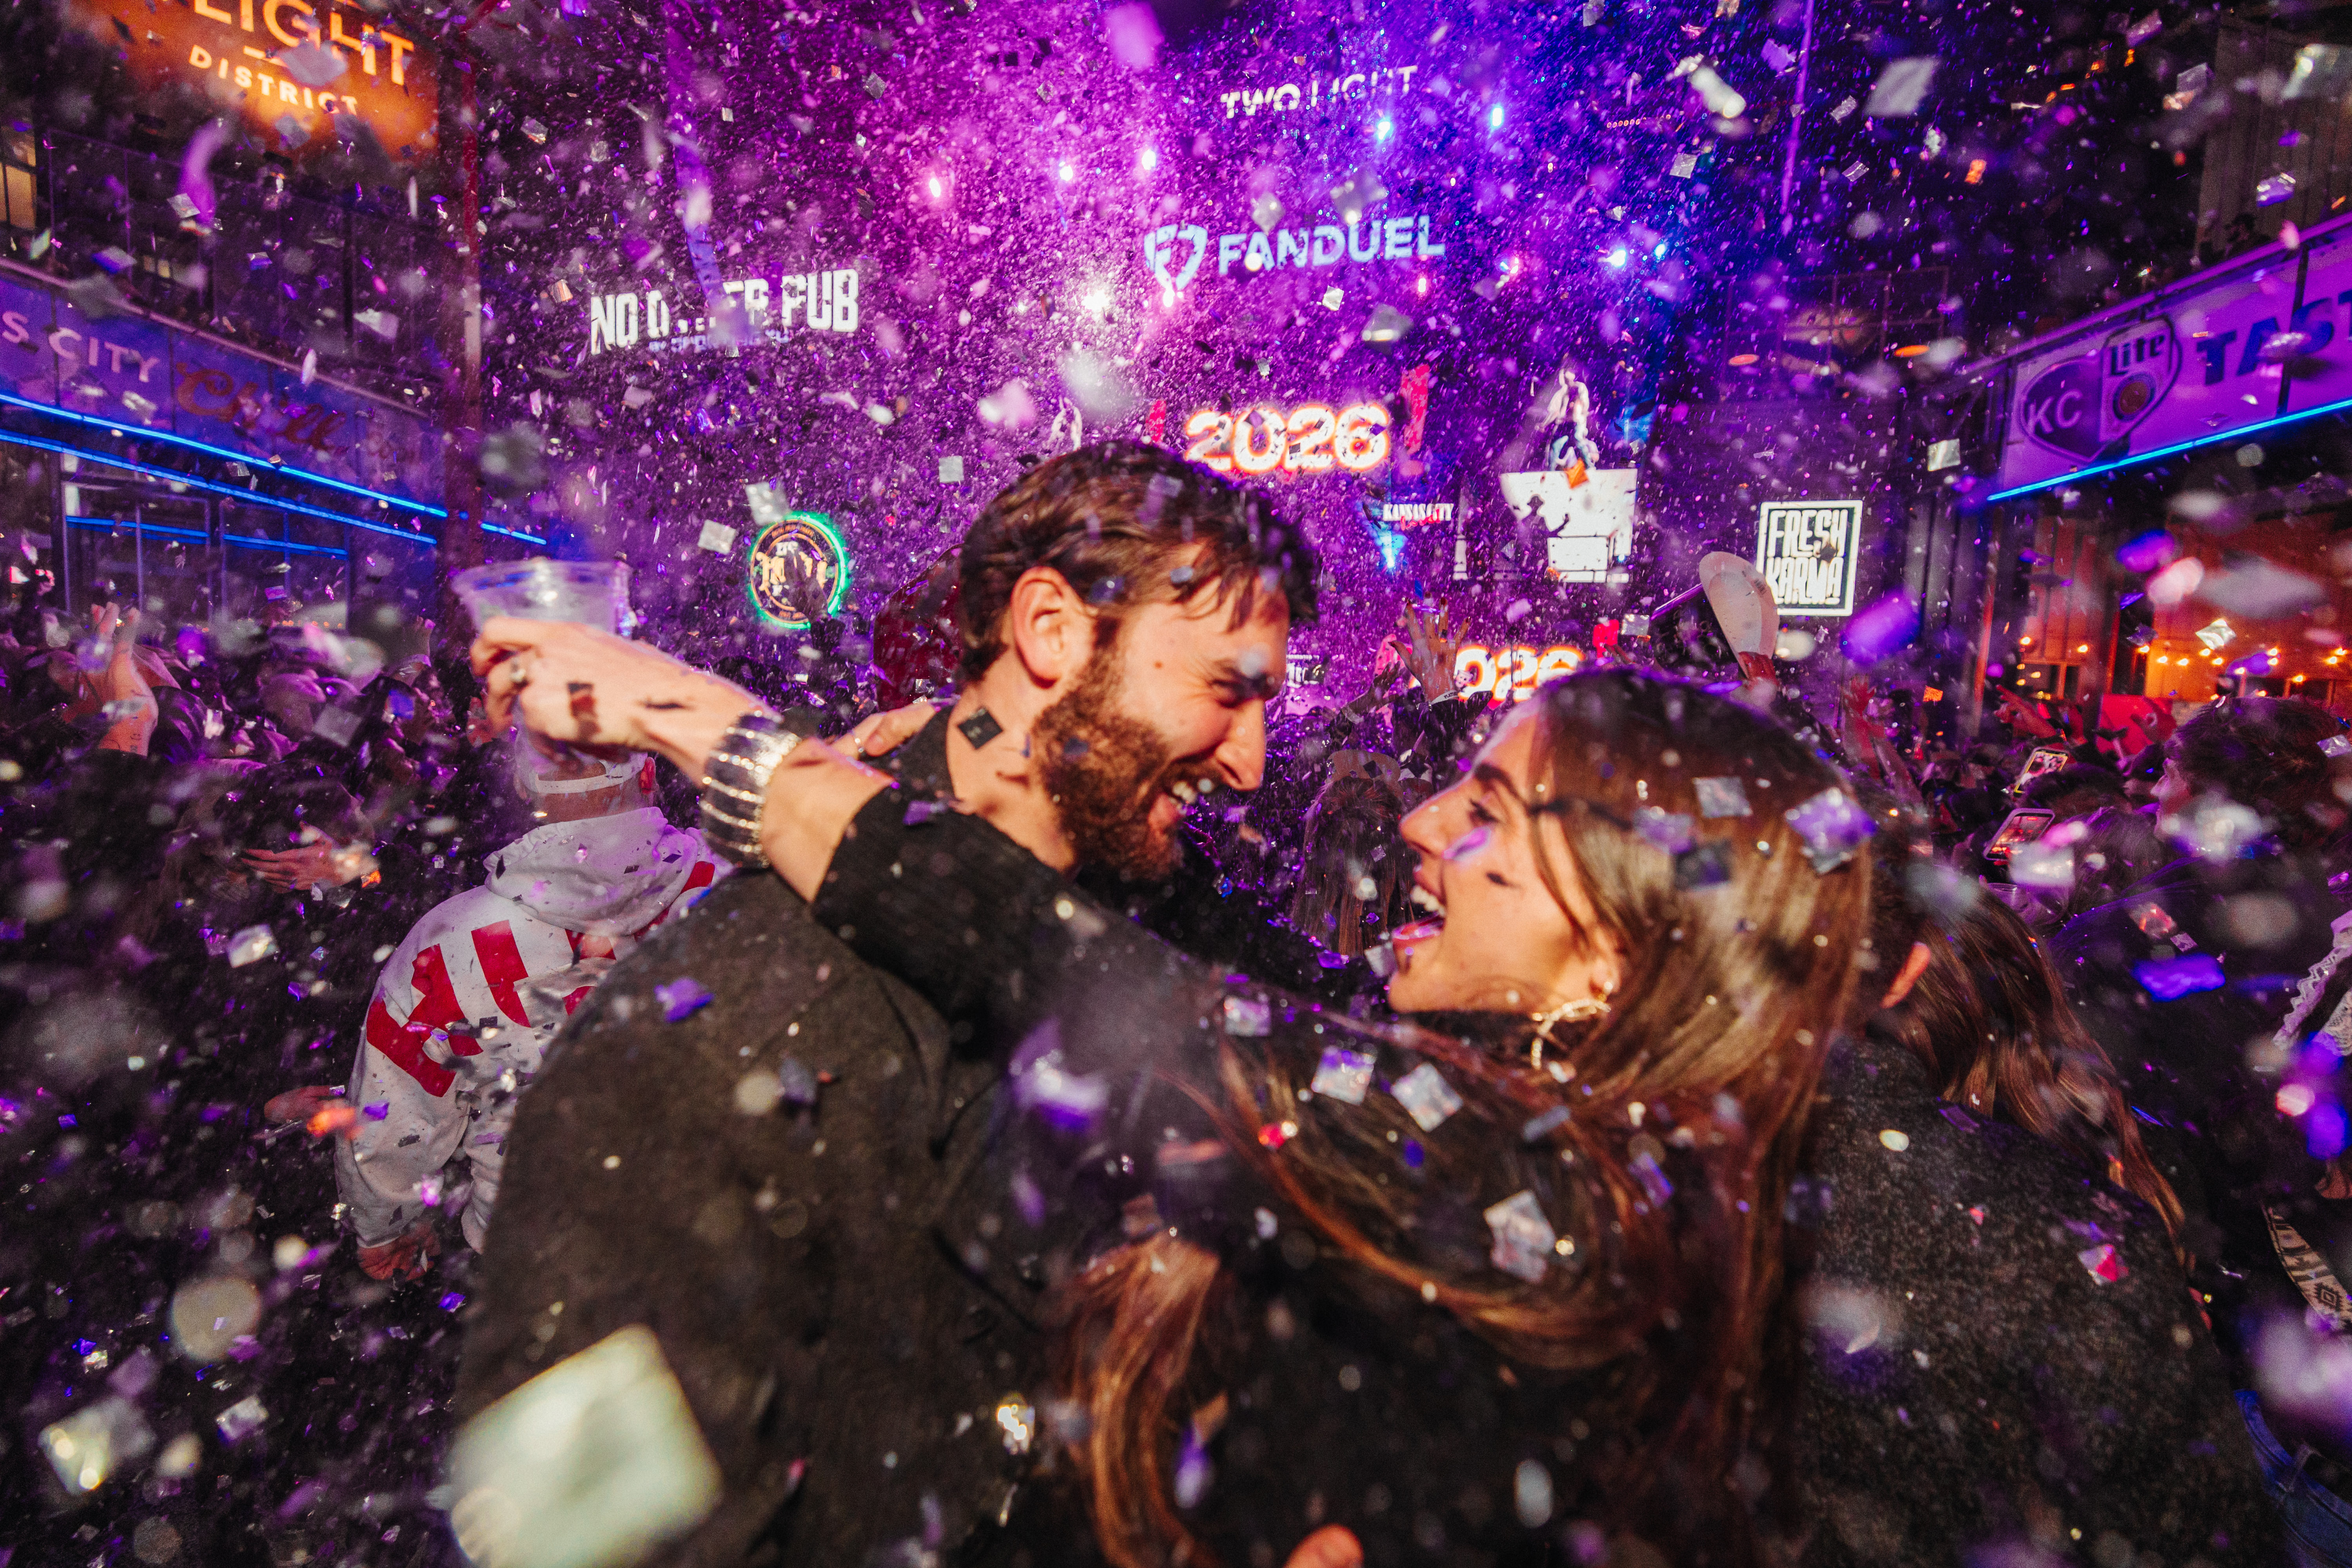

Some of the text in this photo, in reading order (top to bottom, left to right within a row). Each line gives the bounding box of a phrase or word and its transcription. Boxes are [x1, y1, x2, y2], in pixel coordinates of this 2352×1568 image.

[189, 44, 358, 116] DISTRICT
[1220, 83, 1301, 118] TWO
[1218, 215, 1445, 275] FANDUEL
[591, 292, 638, 355] NO
[782, 269, 859, 332] PUB
[49, 327, 160, 383] CITY
[2110, 334, 2165, 376] Lite
[1184, 405, 1389, 474] 2026
[2027, 390, 2082, 434] KC
[1767, 509, 1848, 558] FRESH
[1765, 556, 1844, 605] KARMA
[1411, 645, 1586, 704] 026
